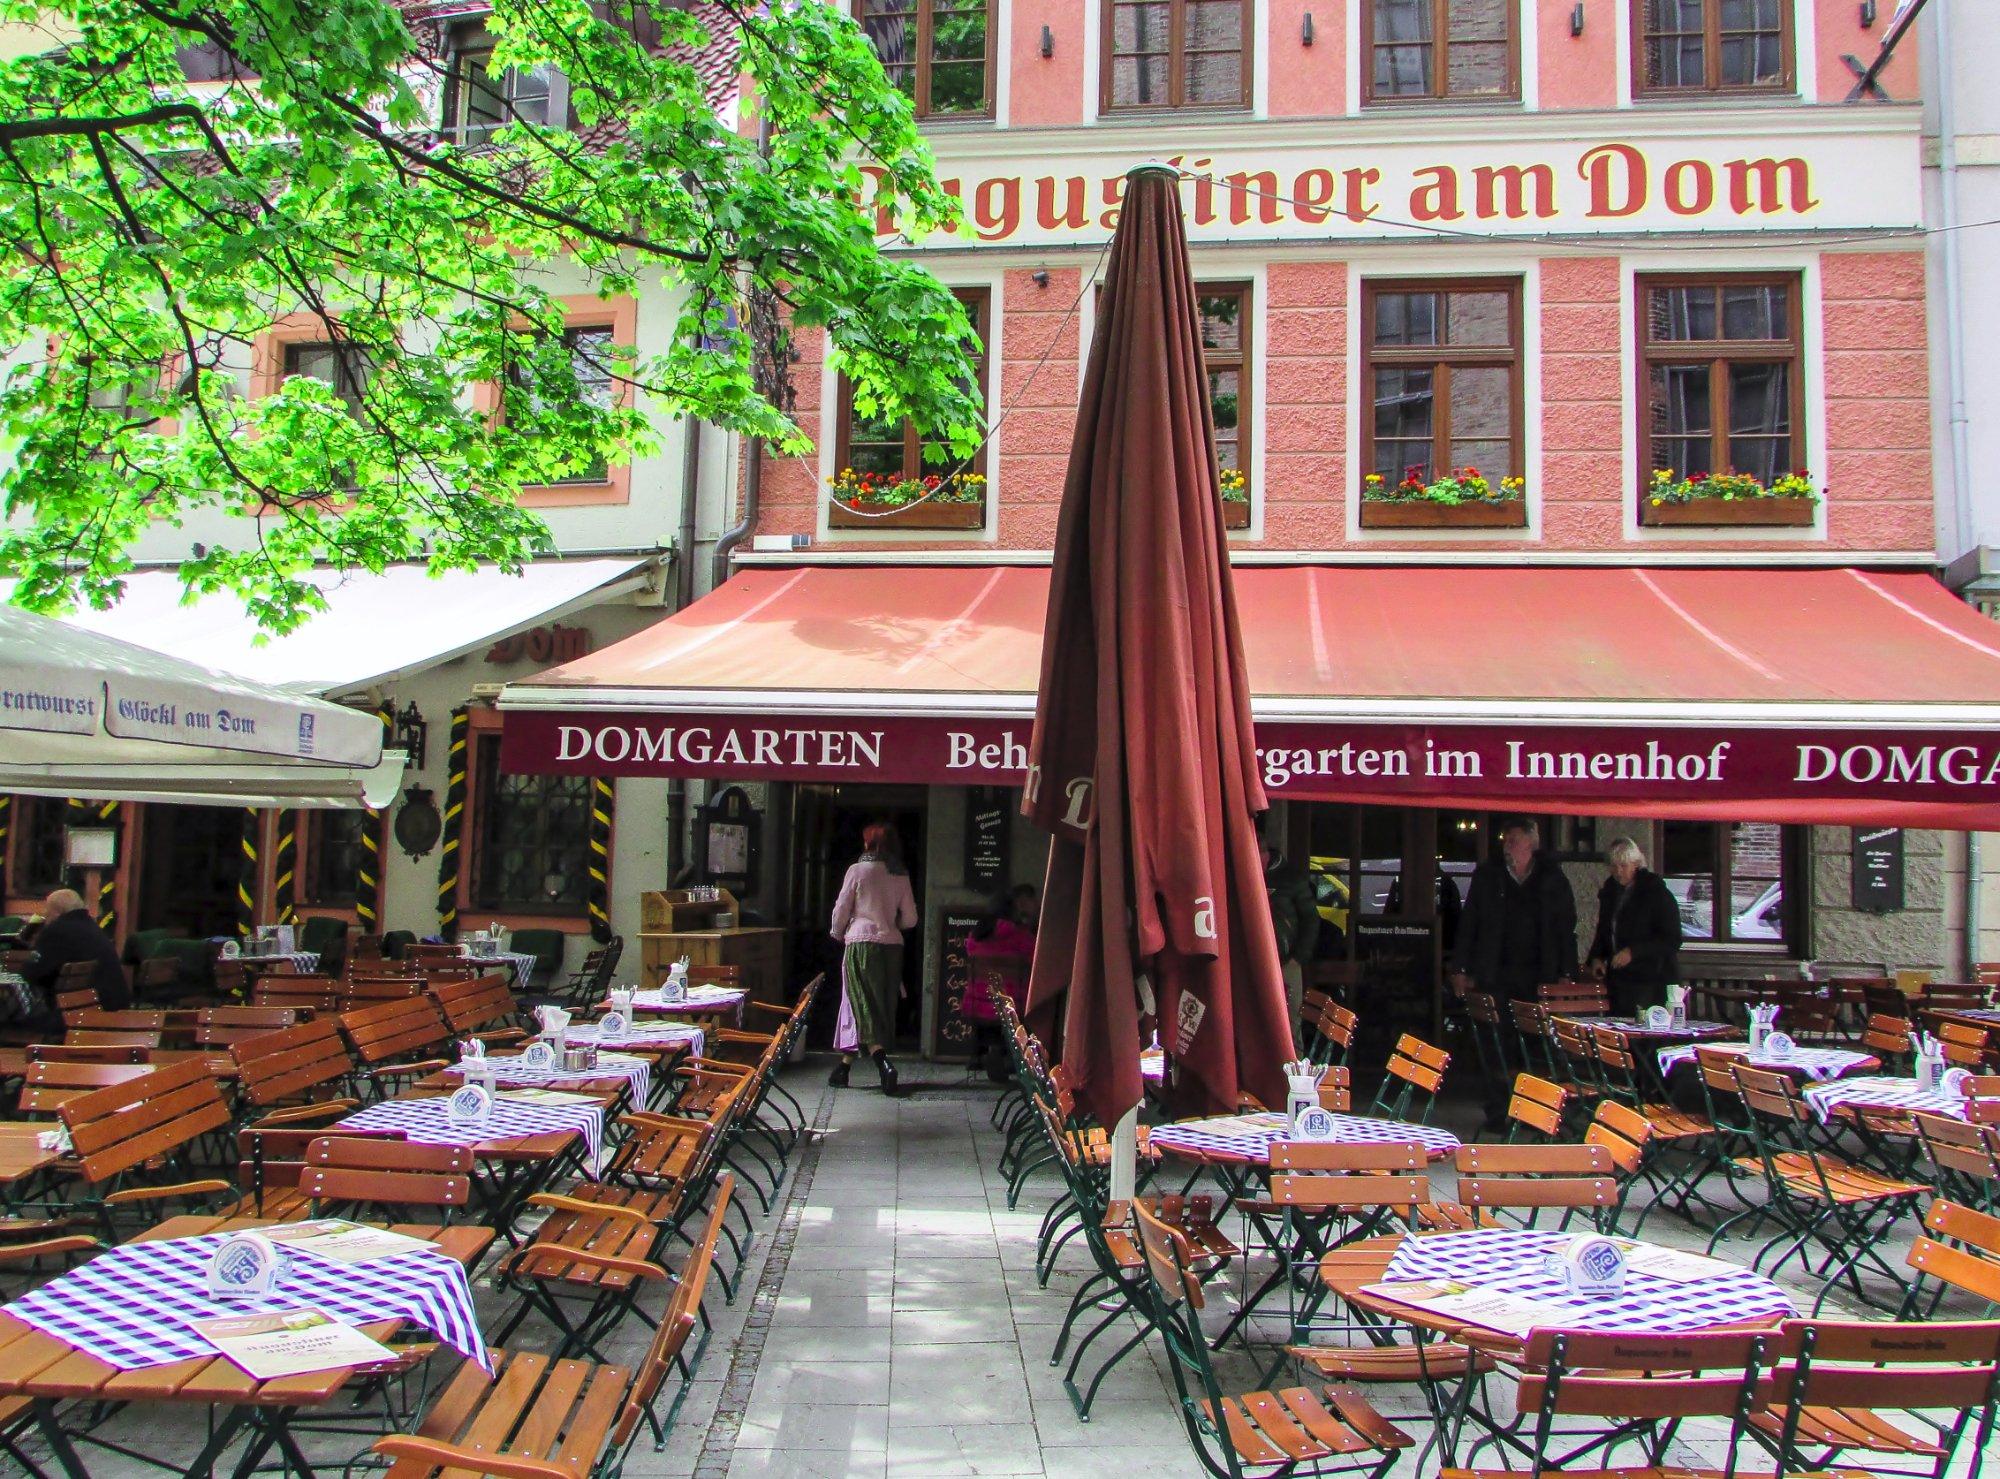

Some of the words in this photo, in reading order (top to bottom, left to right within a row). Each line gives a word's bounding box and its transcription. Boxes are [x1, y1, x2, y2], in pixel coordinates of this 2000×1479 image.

[838, 155, 1381, 241] Aguiner
[1409, 163, 1561, 222] am
[1577, 143, 1820, 218] Dom
[3, 690, 95, 716] ratwurst
[119, 697, 177, 726] Glöckl
[185, 711, 211, 730] am
[217, 708, 256, 735] Dom
[555, 725, 885, 768] DOMGARTEN
[945, 731, 1029, 770] Beh
[1254, 741, 1411, 787] garten
[1424, 739, 1484, 778] im
[1505, 740, 1732, 781] Innenhof
